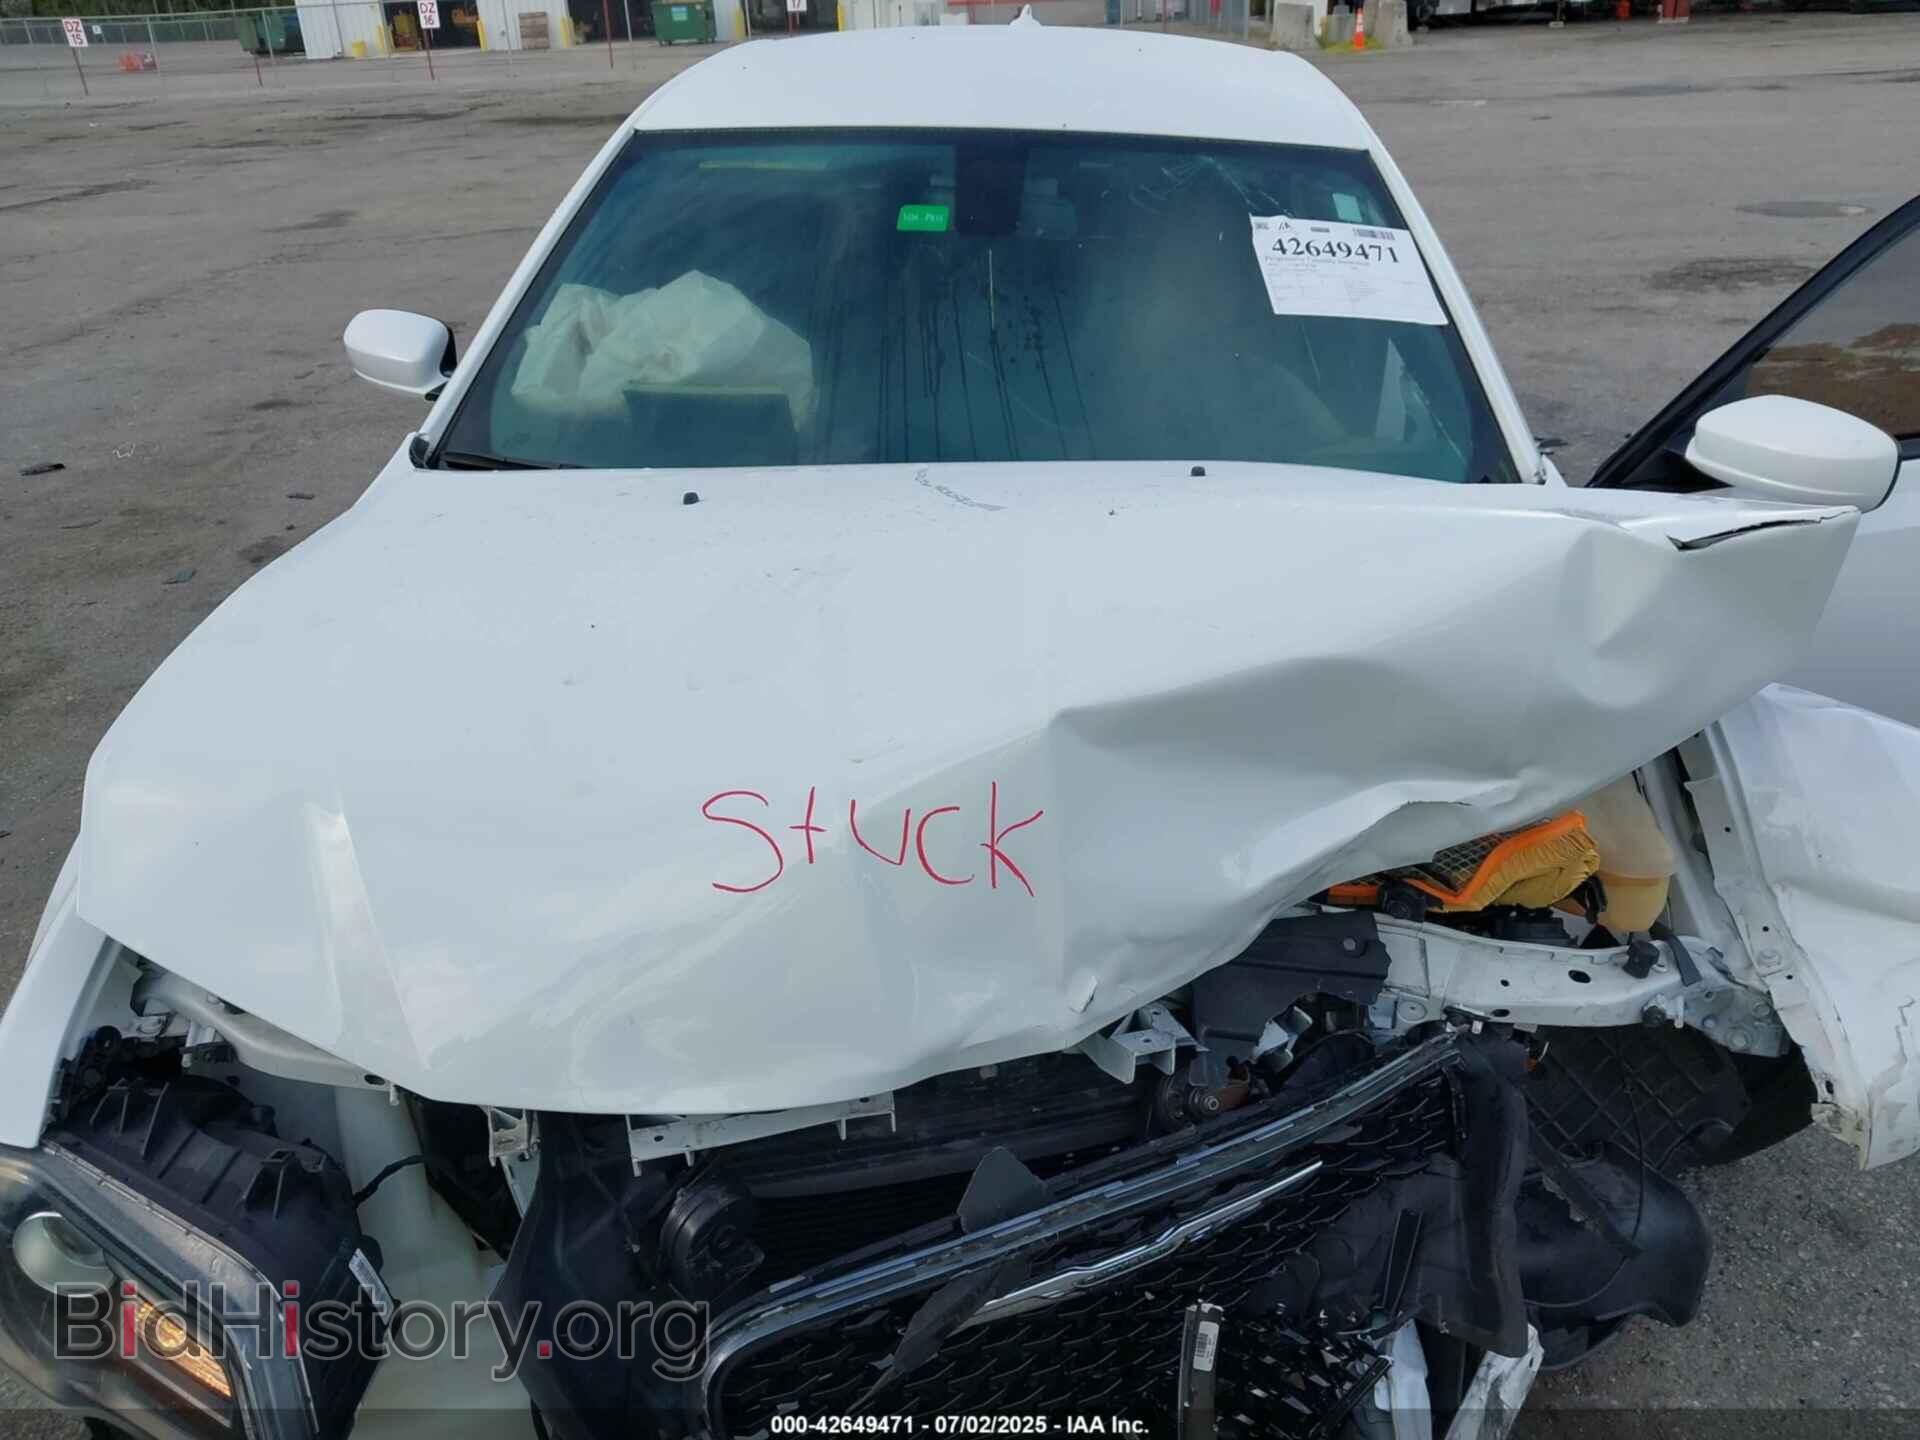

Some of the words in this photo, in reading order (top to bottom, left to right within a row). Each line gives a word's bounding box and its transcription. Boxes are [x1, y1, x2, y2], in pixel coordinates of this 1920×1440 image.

[420, 2, 436, 14] DZ
[424, 14, 435, 25] 16
[63, 20, 82, 33] DZ
[71, 33, 84, 46] 15
[1271, 236, 1400, 263] 42649471
